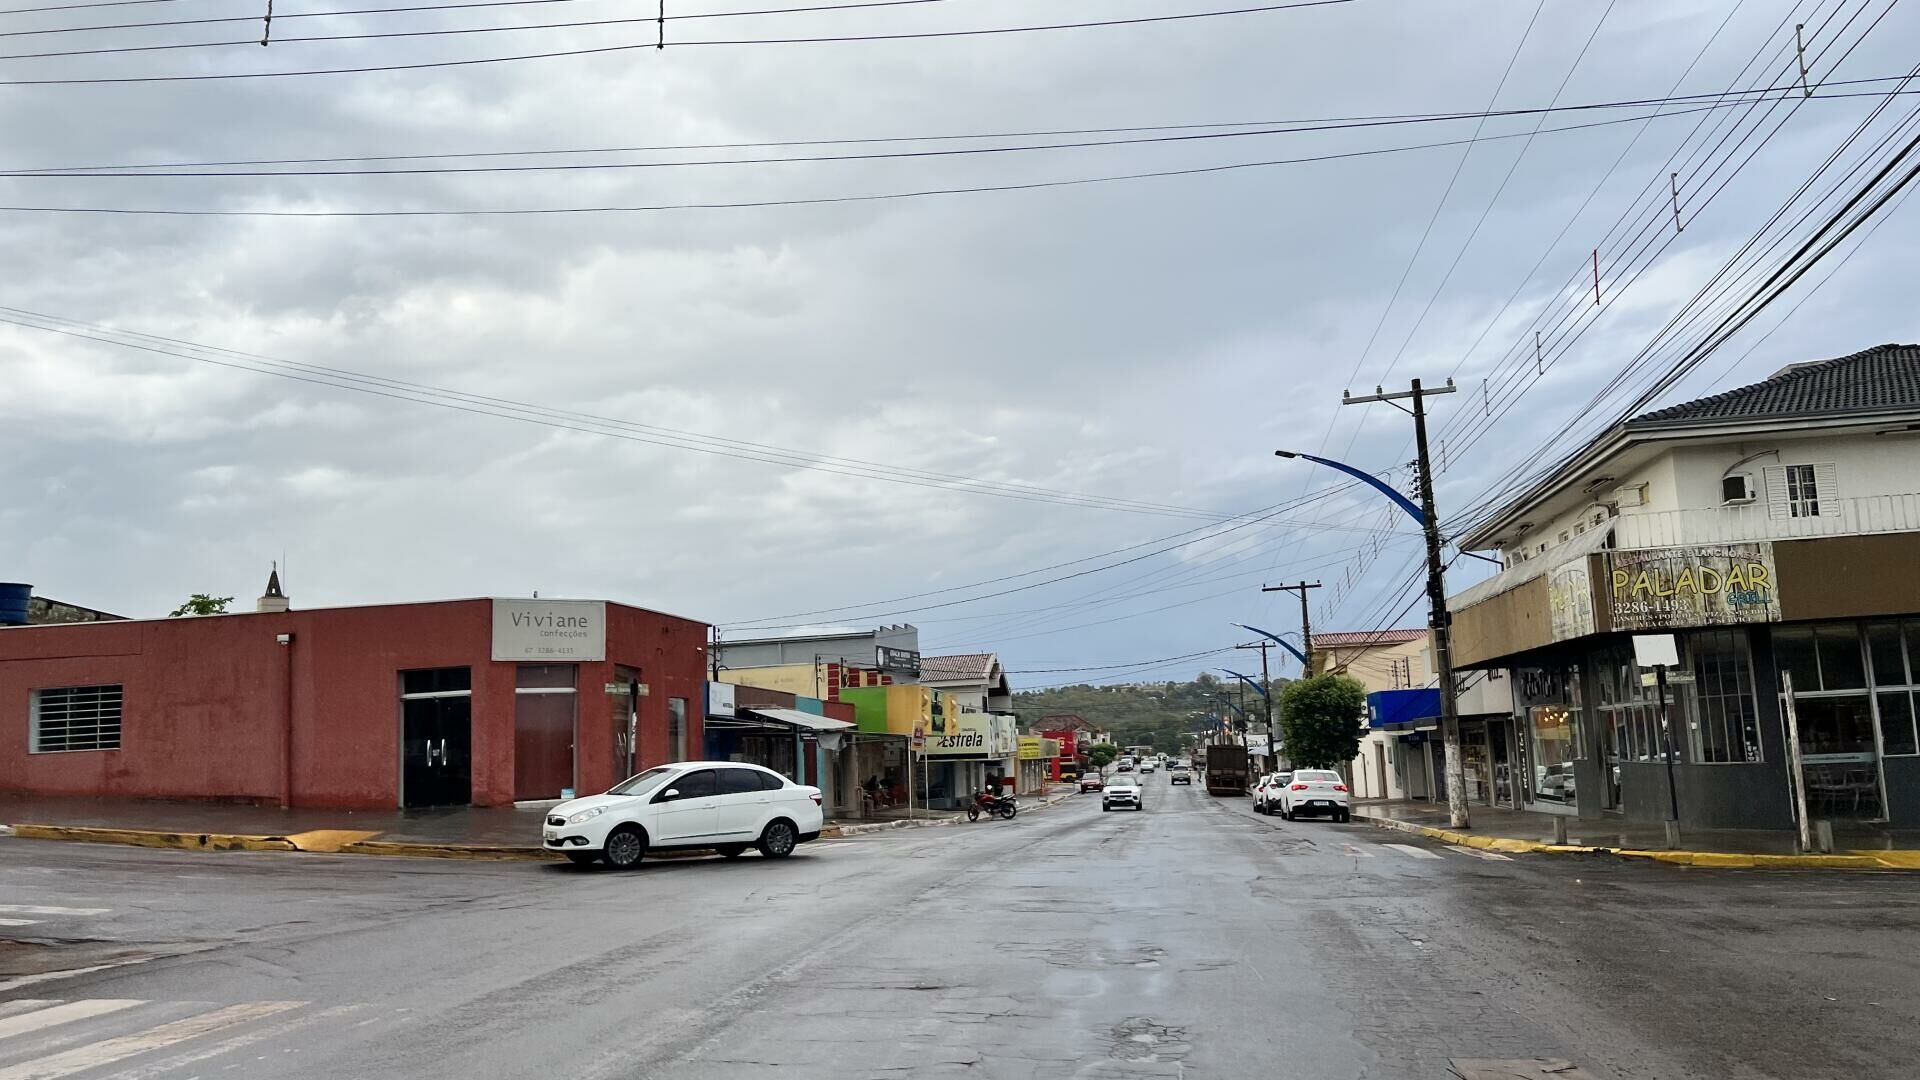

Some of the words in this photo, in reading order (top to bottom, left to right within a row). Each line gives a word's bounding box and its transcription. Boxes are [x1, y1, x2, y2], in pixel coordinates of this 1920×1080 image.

[1616, 550, 1683, 568] RESTAURANTE
[1696, 549, 1763, 563] LANCHONETE
[1612, 562, 1771, 598] PALADAR
[1727, 590, 1773, 605] GRILL
[1614, 599, 1688, 614] 3286-1493
[511, 611, 589, 628] Viviane
[540, 630, 588, 639] confecções
[942, 732, 983, 748] Estrela
